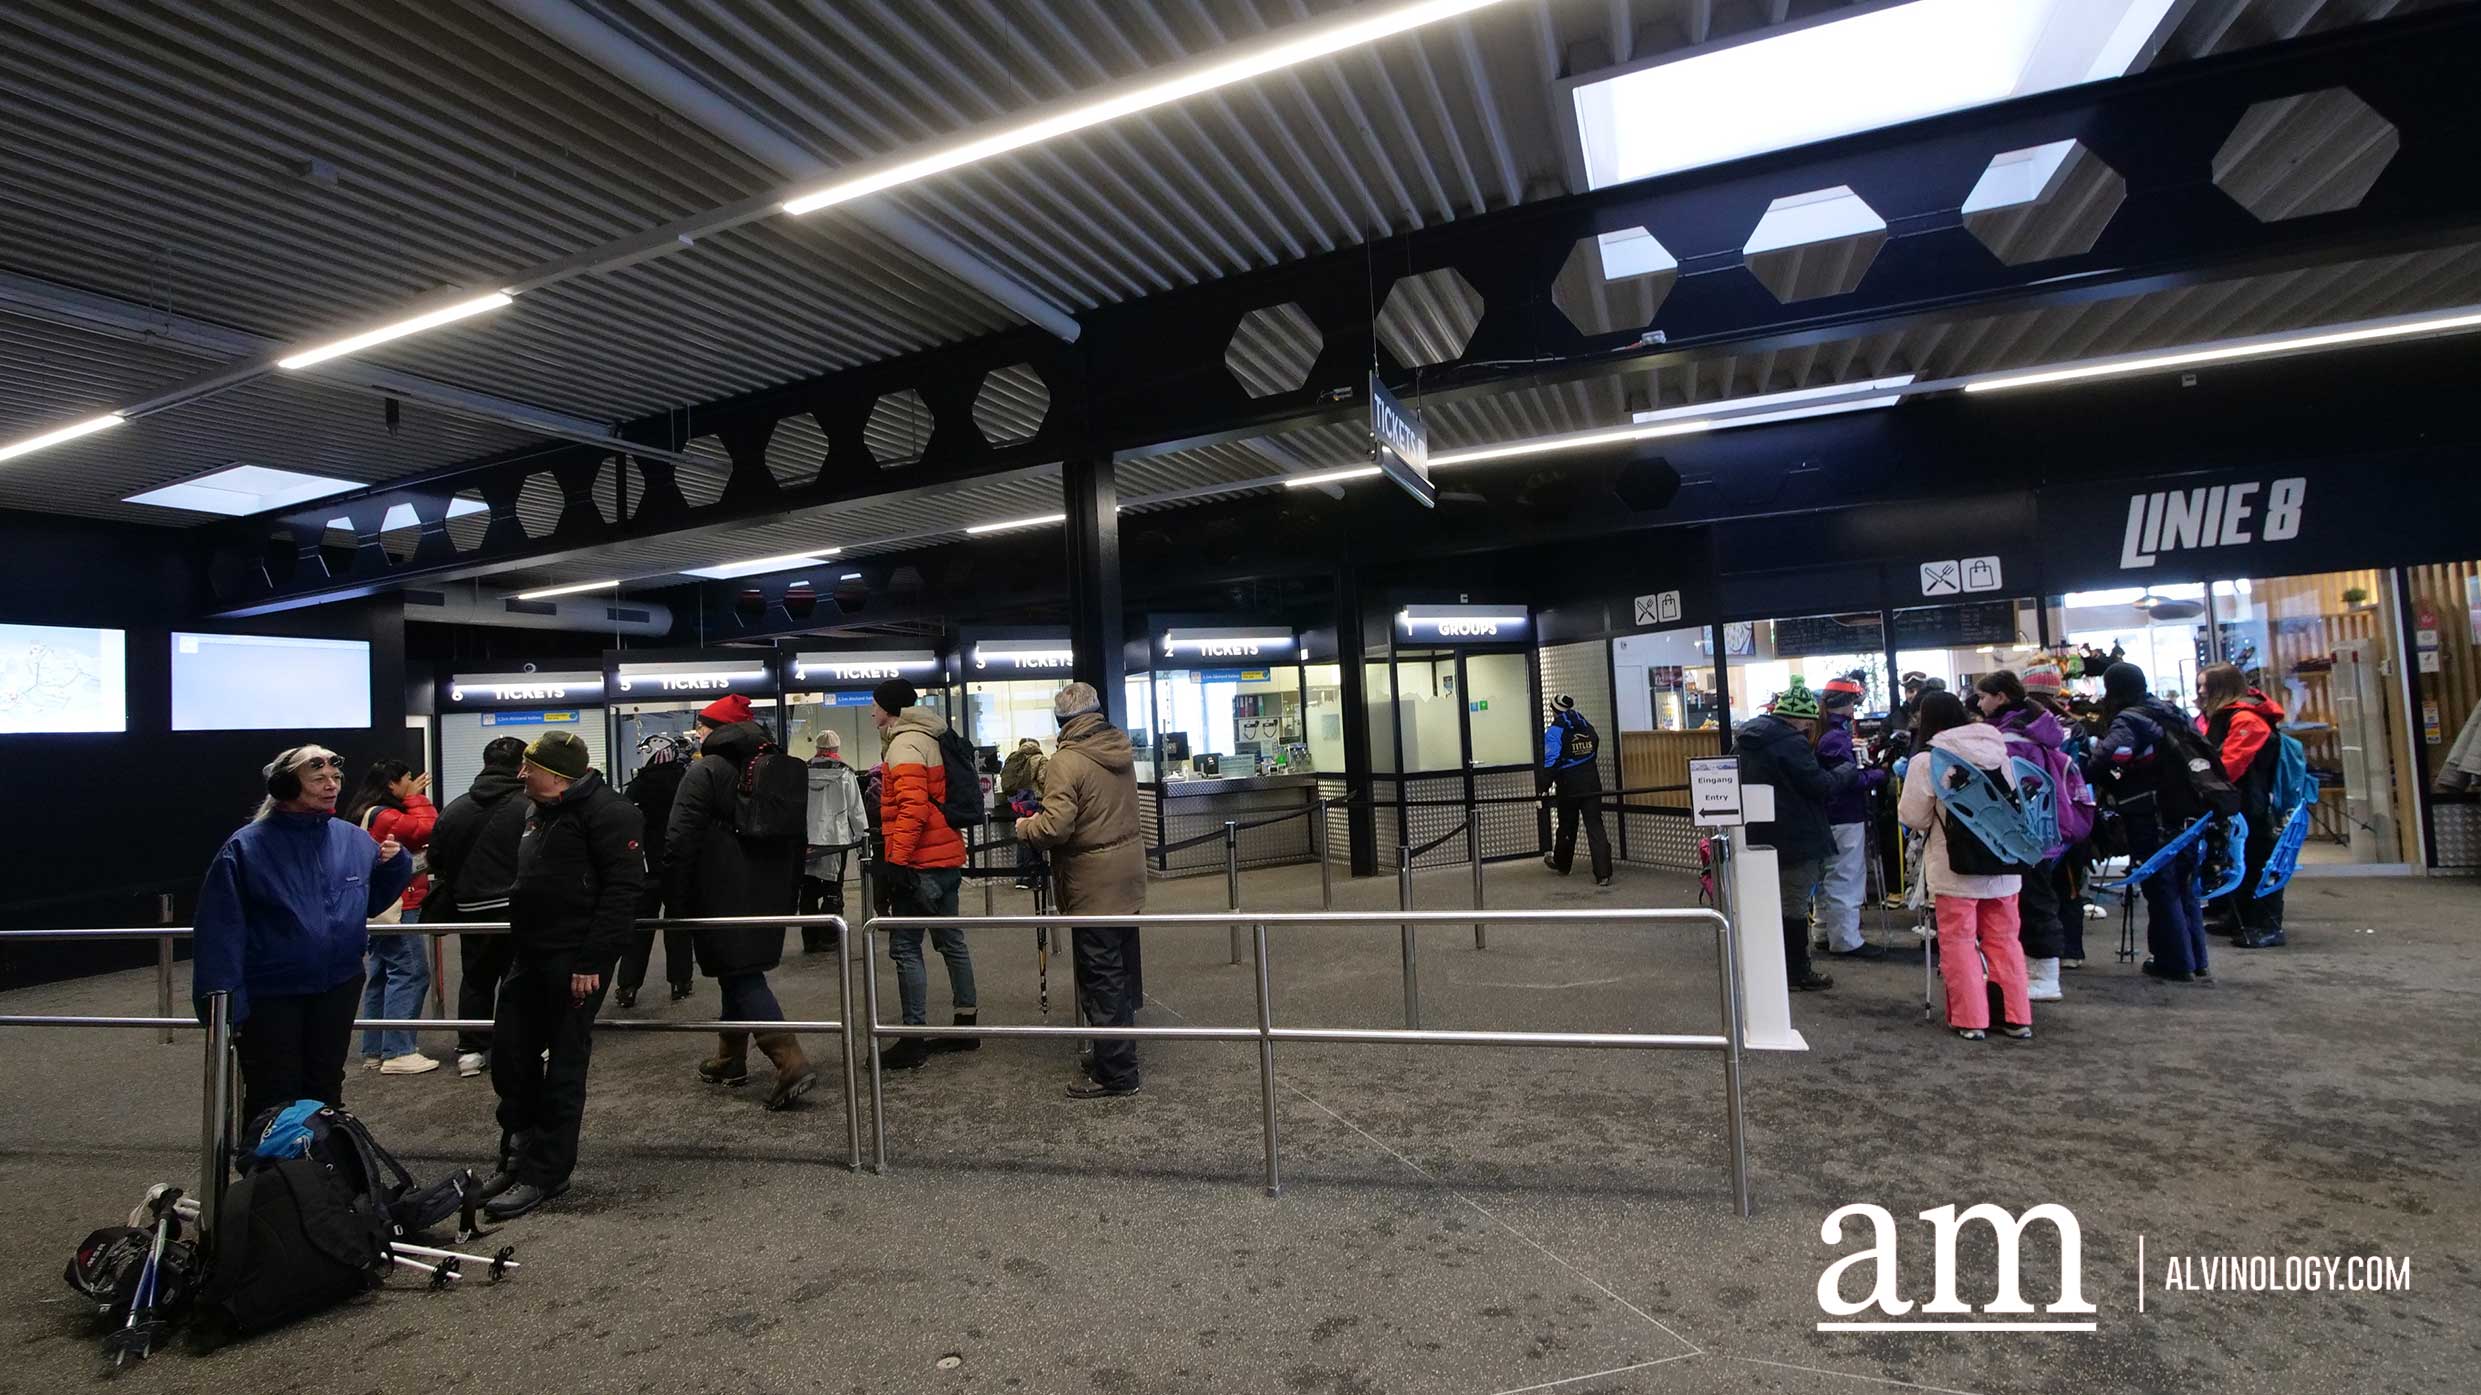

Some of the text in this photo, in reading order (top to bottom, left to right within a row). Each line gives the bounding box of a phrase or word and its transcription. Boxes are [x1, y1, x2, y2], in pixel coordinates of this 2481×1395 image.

[1374, 393, 1416, 457] TICKETS
[2120, 477, 2307, 569] LINIE 8
[1438, 622, 1498, 636] GROUPS
[1200, 643, 1260, 657] TICKETS
[795, 666, 900, 681] 4 TICKETS
[660, 677, 730, 690] TICKETS
[451, 684, 566, 701] 6 TICKETS
[1572, 741, 1593, 751] TITLIS
[1698, 777, 1733, 785] Eingang
[1705, 794, 1728, 802] Entry
